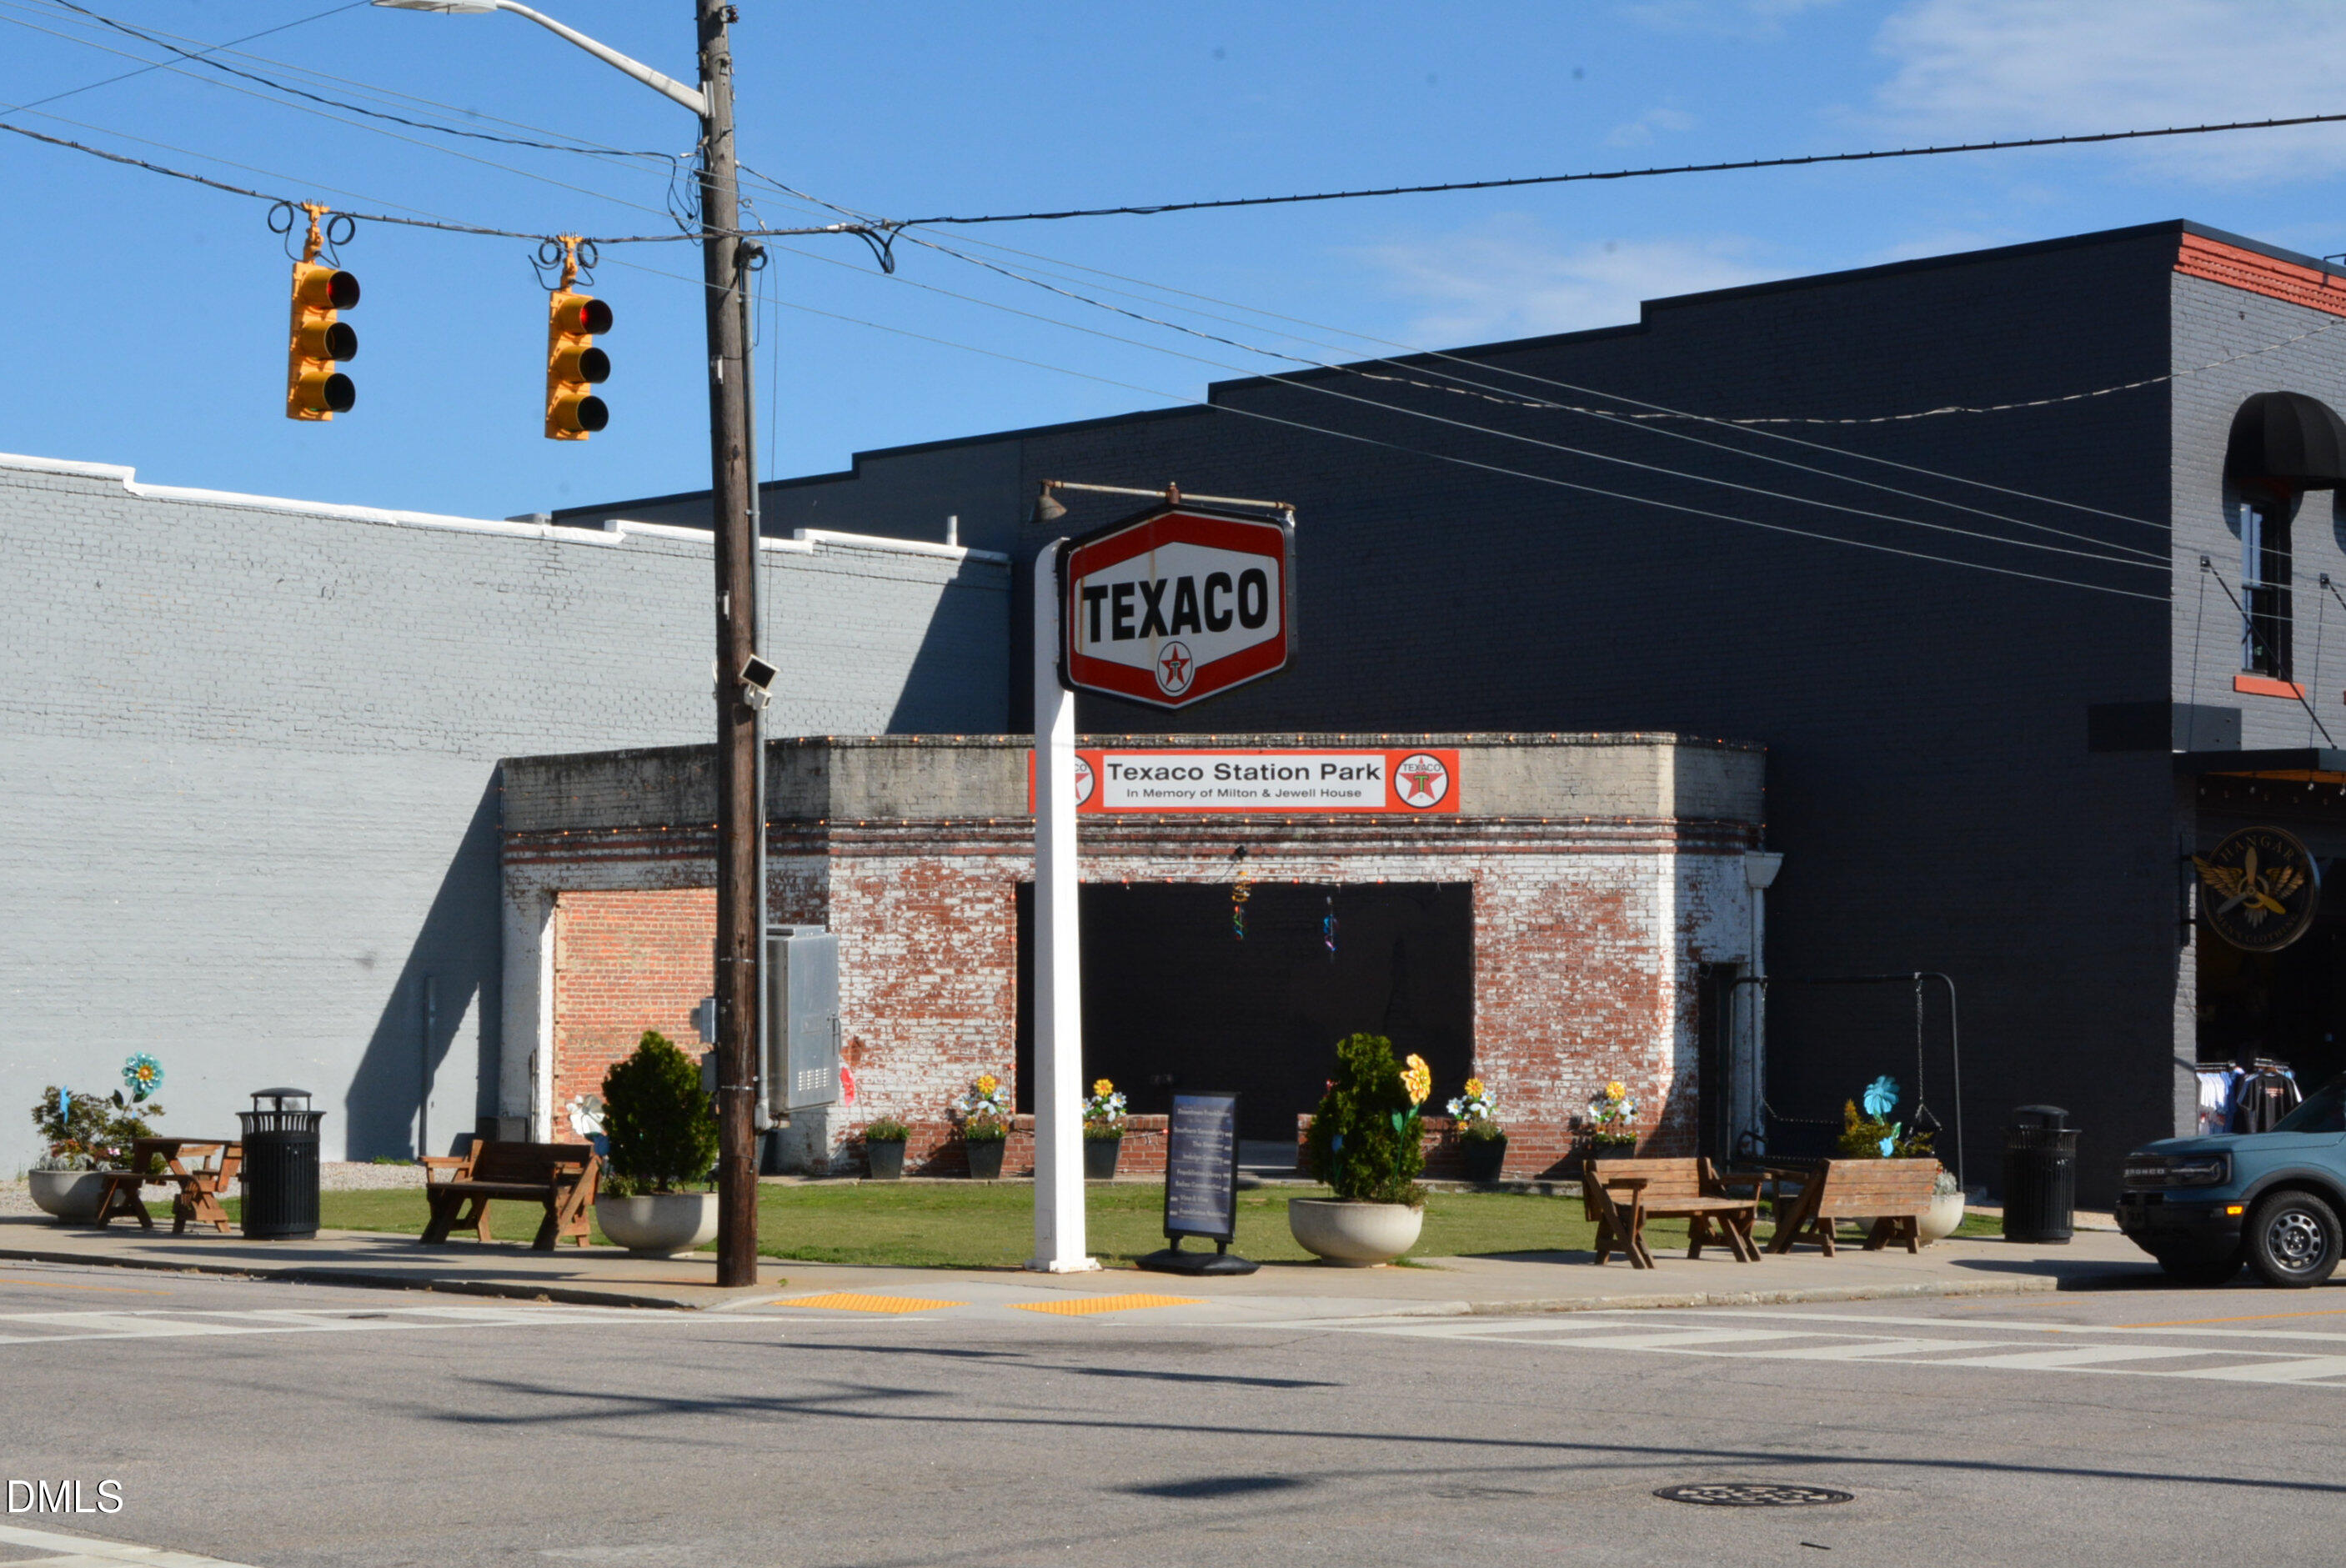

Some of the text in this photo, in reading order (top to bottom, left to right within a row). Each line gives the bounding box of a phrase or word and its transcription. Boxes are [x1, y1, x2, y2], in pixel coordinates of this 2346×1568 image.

[1083, 568, 1268, 643] TEXACO
[1107, 763, 1204, 781] Texaco
[1214, 763, 1310, 781] Station
[1321, 763, 1381, 781] Park
[1402, 764, 1441, 772] TEXACO
[1414, 775, 1430, 792] T
[1127, 789, 1361, 799] In Memory of Milton & Jewell House
[2221, 834, 2294, 861] HANGAR
[2245, 914, 2298, 942] CLOTHING
[2123, 1168, 2165, 1177] BRONCO
